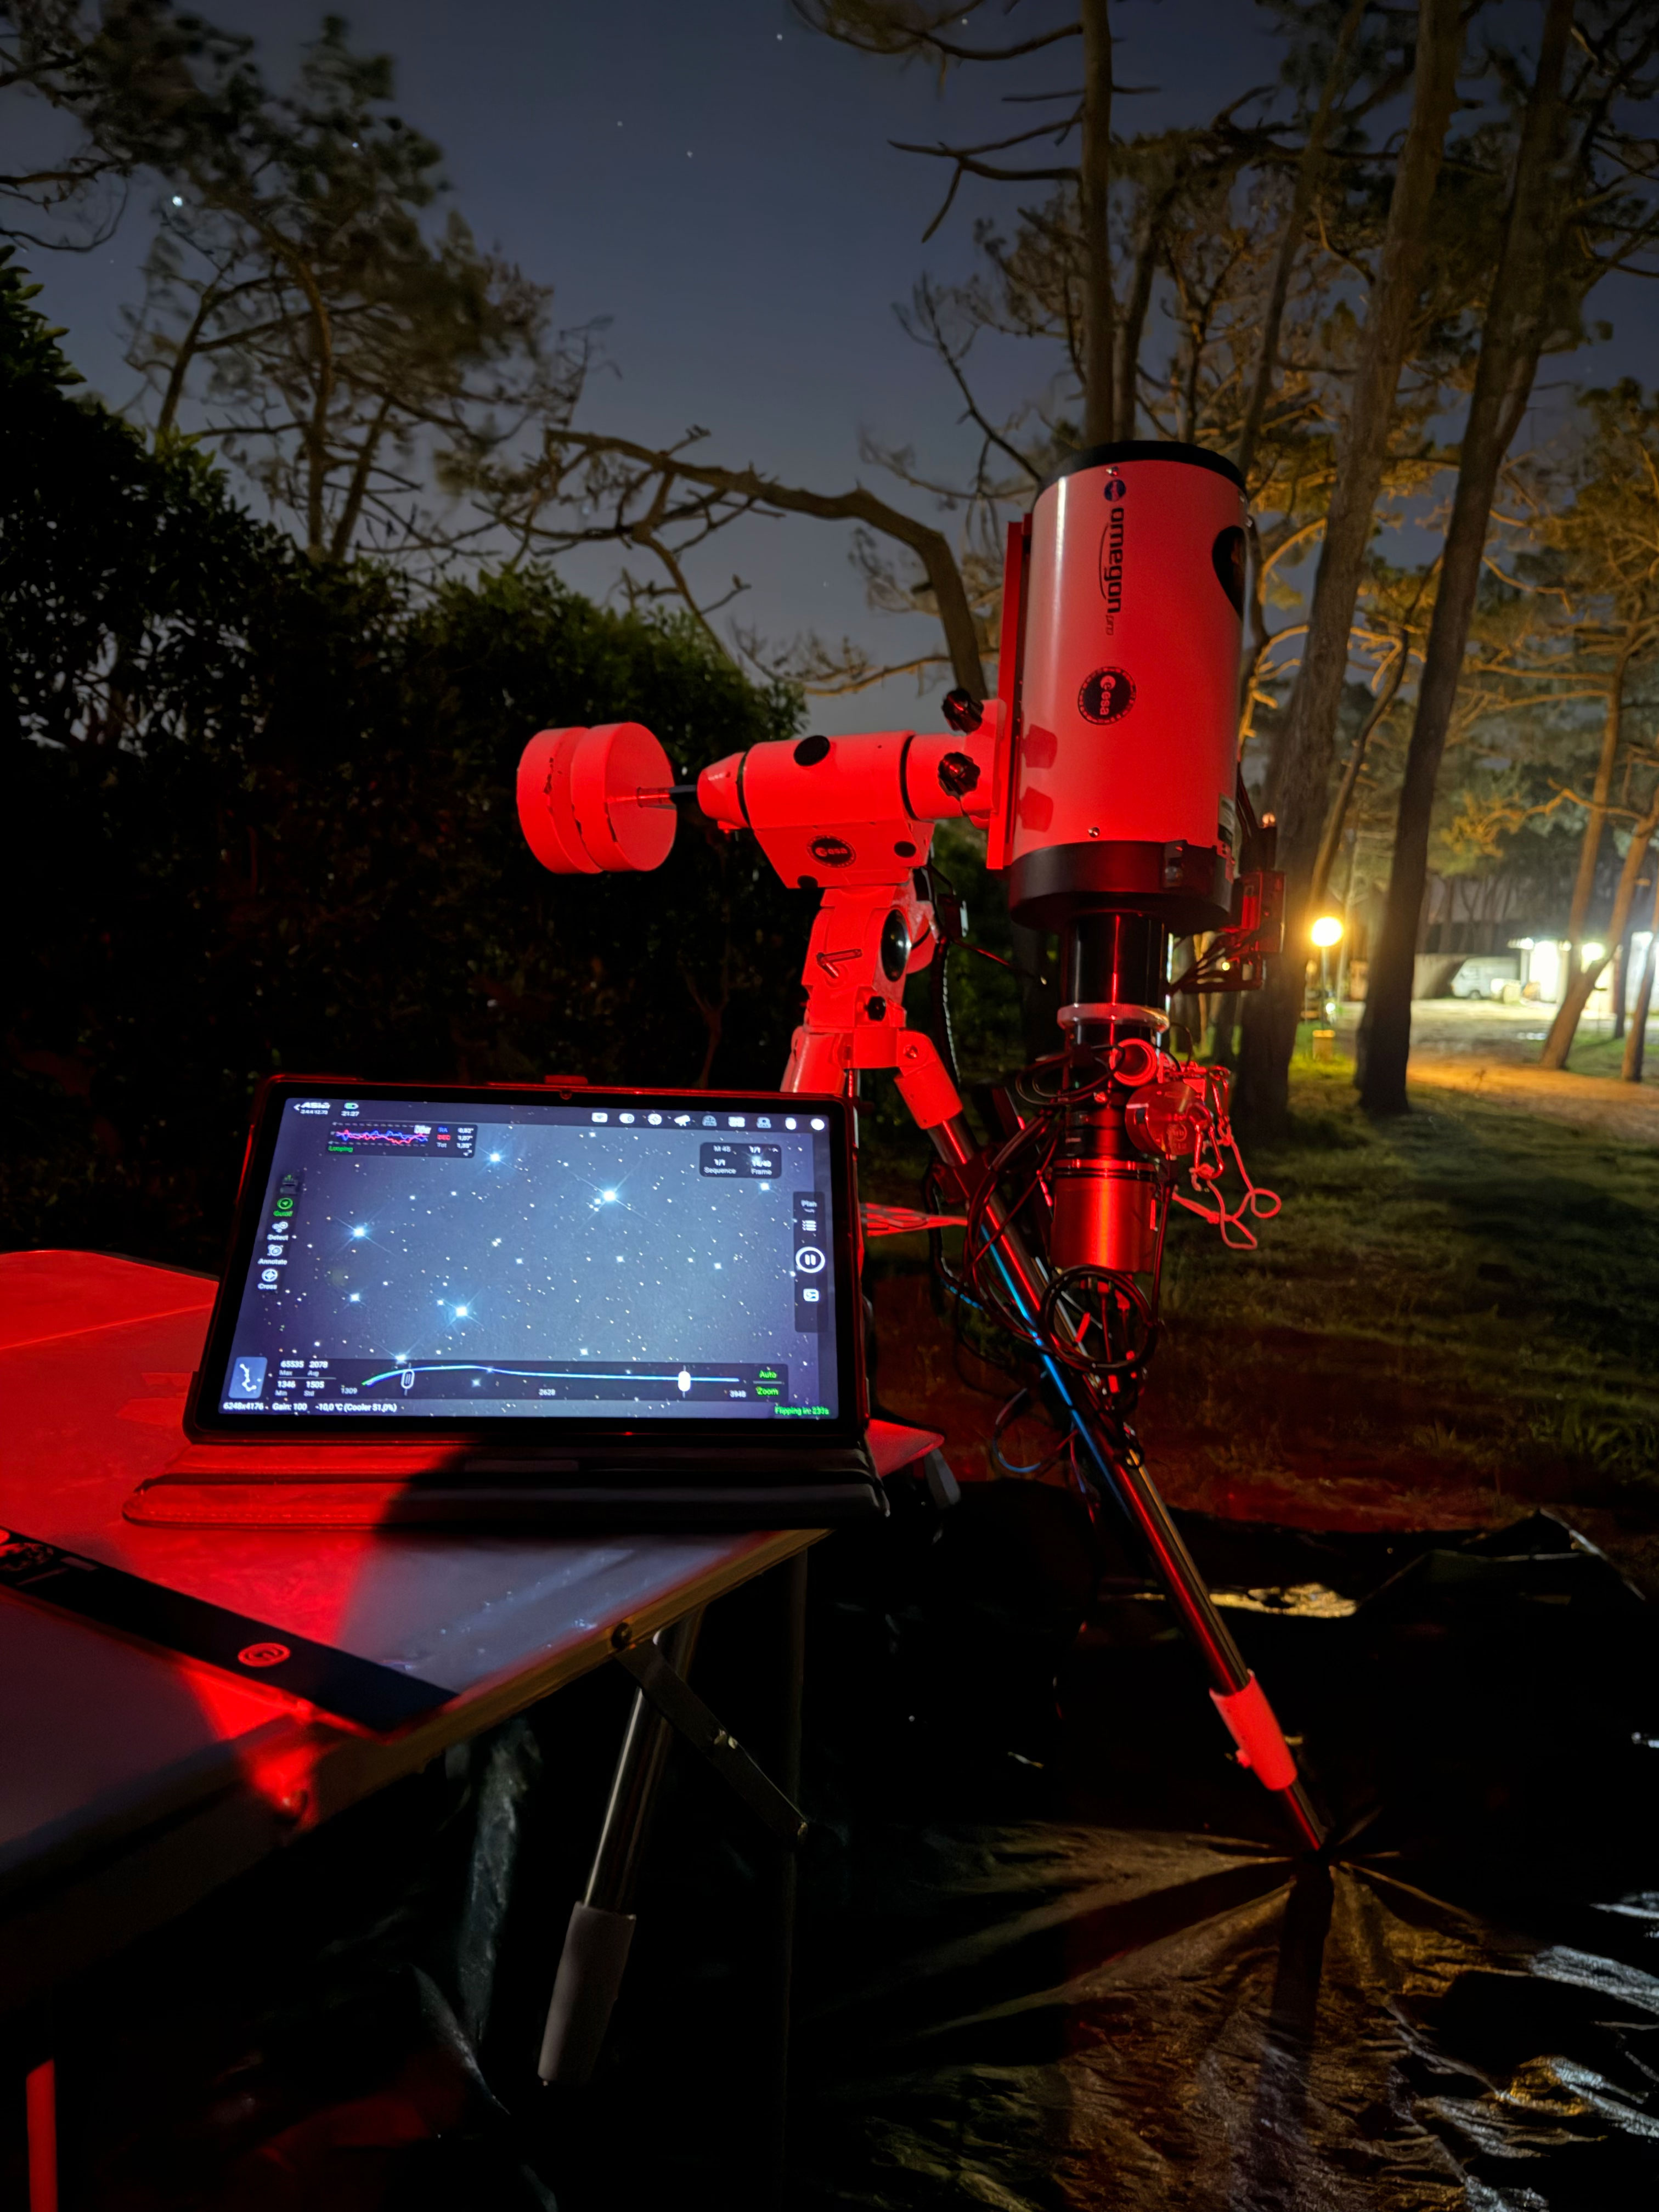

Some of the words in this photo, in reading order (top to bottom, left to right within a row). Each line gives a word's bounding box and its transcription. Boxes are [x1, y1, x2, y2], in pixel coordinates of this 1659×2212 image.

[1104, 507, 1124, 613] omegon
[703, 1166, 737, 1175] Sequence
[801, 1199, 817, 1207] Plan
[759, 1370, 777, 1379] Auto
[223, 1402, 264, 1410] 6248x4176
[774, 1406, 802, 1416] Flipping
